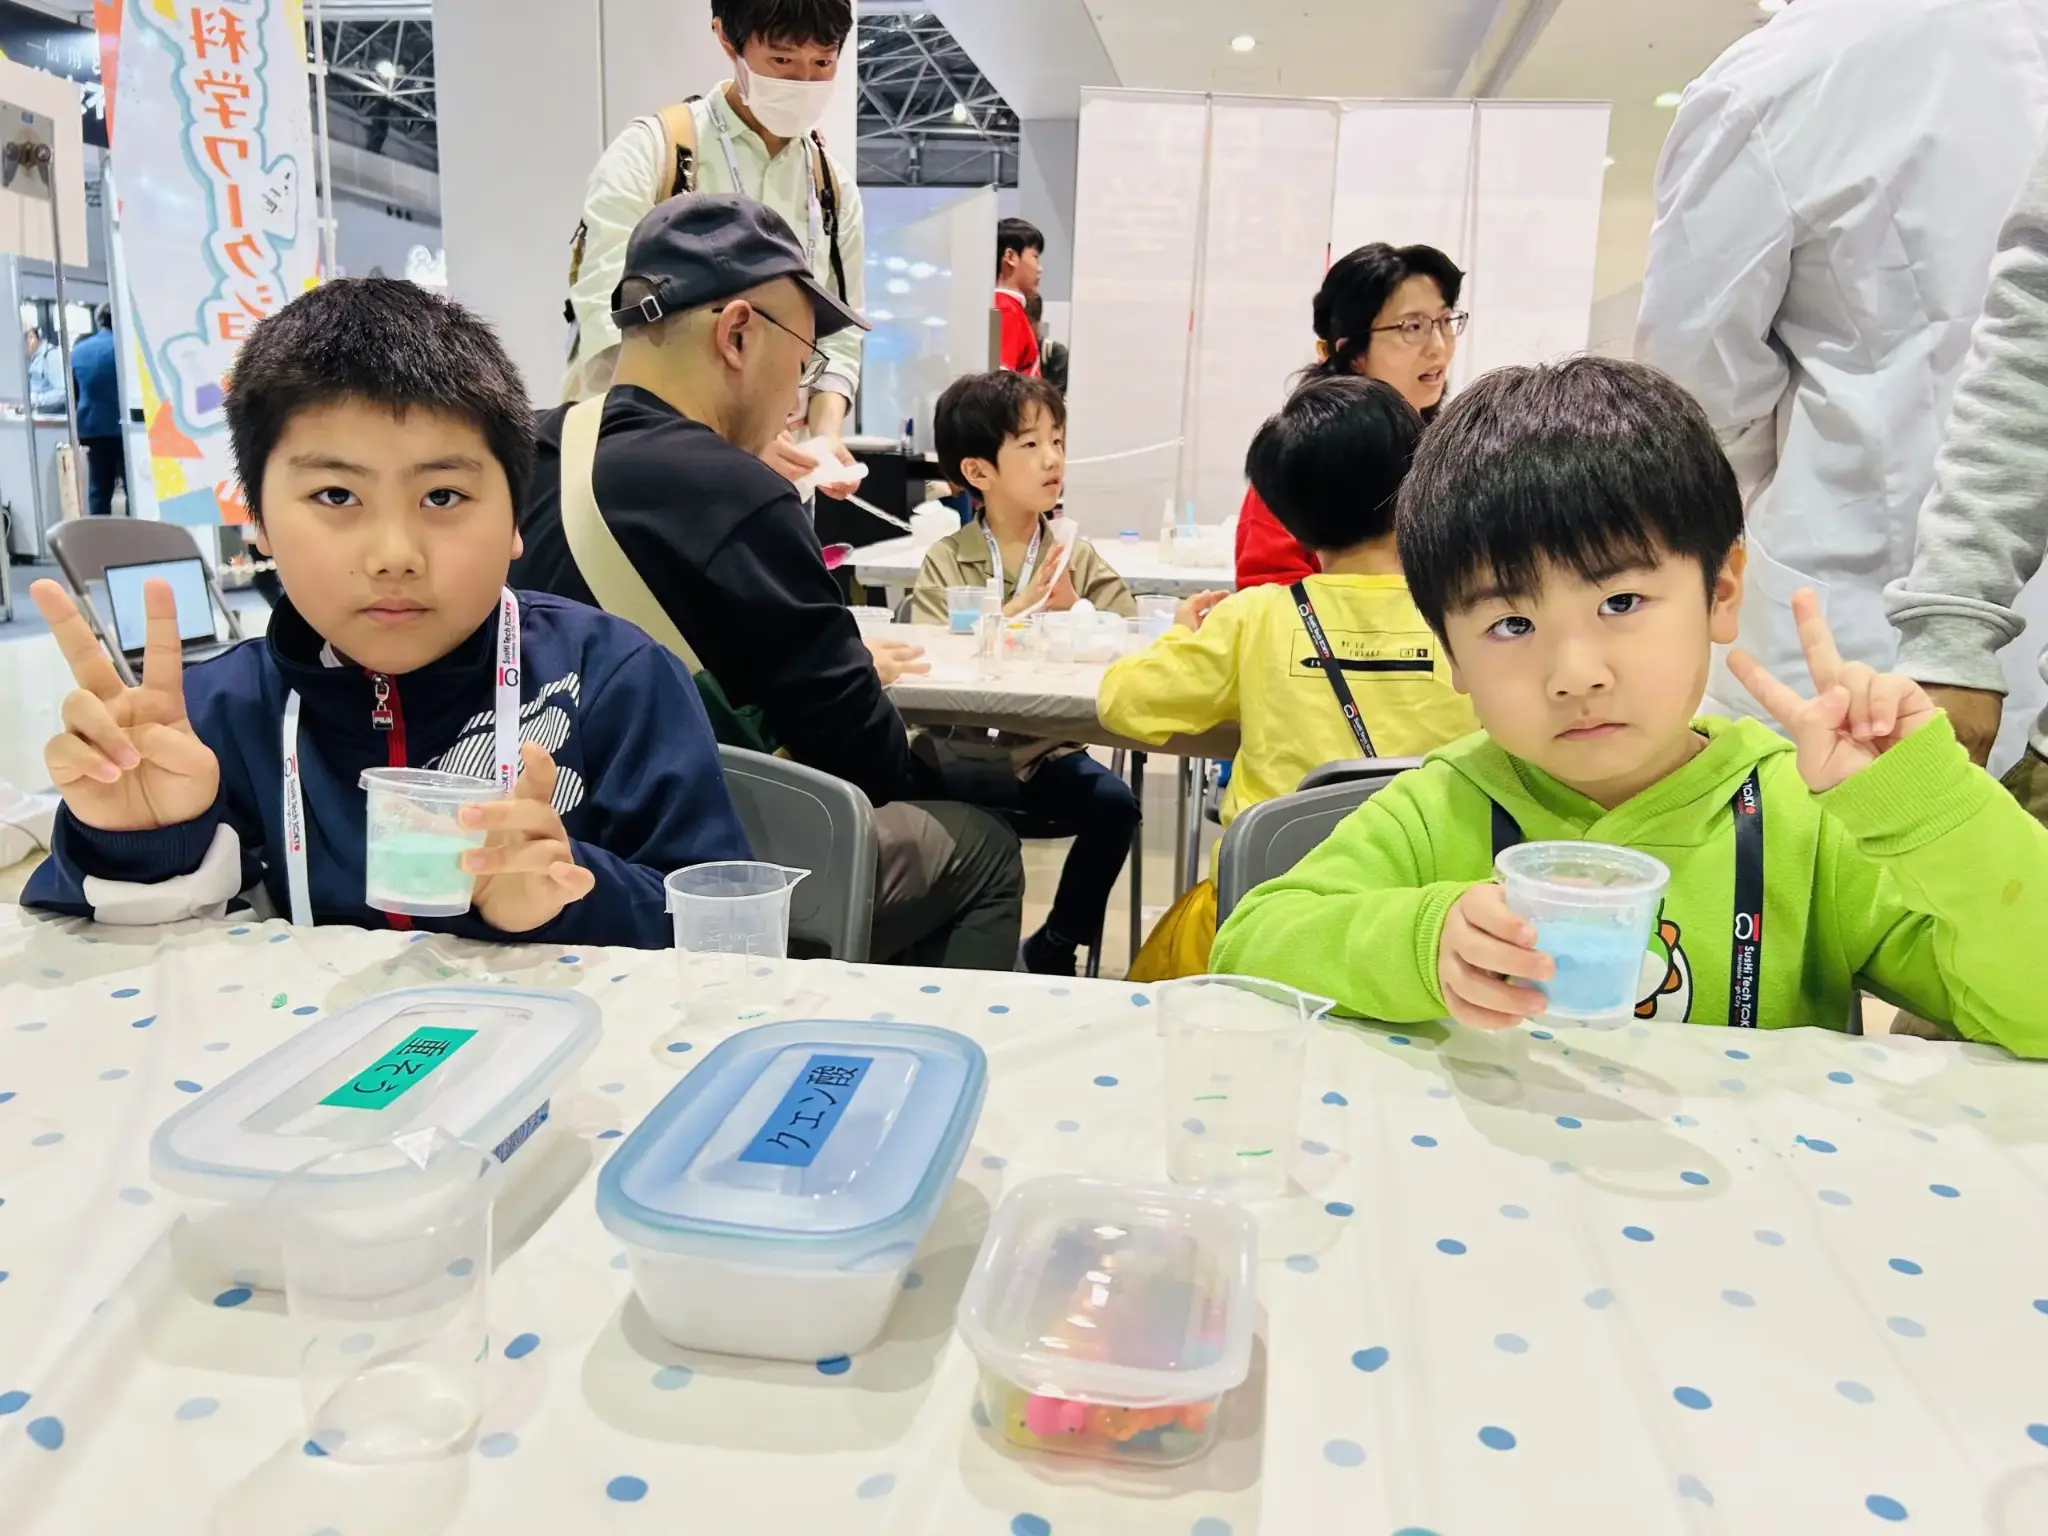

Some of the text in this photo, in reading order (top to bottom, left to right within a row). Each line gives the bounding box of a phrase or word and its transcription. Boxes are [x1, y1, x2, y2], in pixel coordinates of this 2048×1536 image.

[503, 627, 511, 644] Tech
[1740, 945, 1754, 1029] SusHi Tech TOK
[353, 1037, 451, 1093] 重そう
